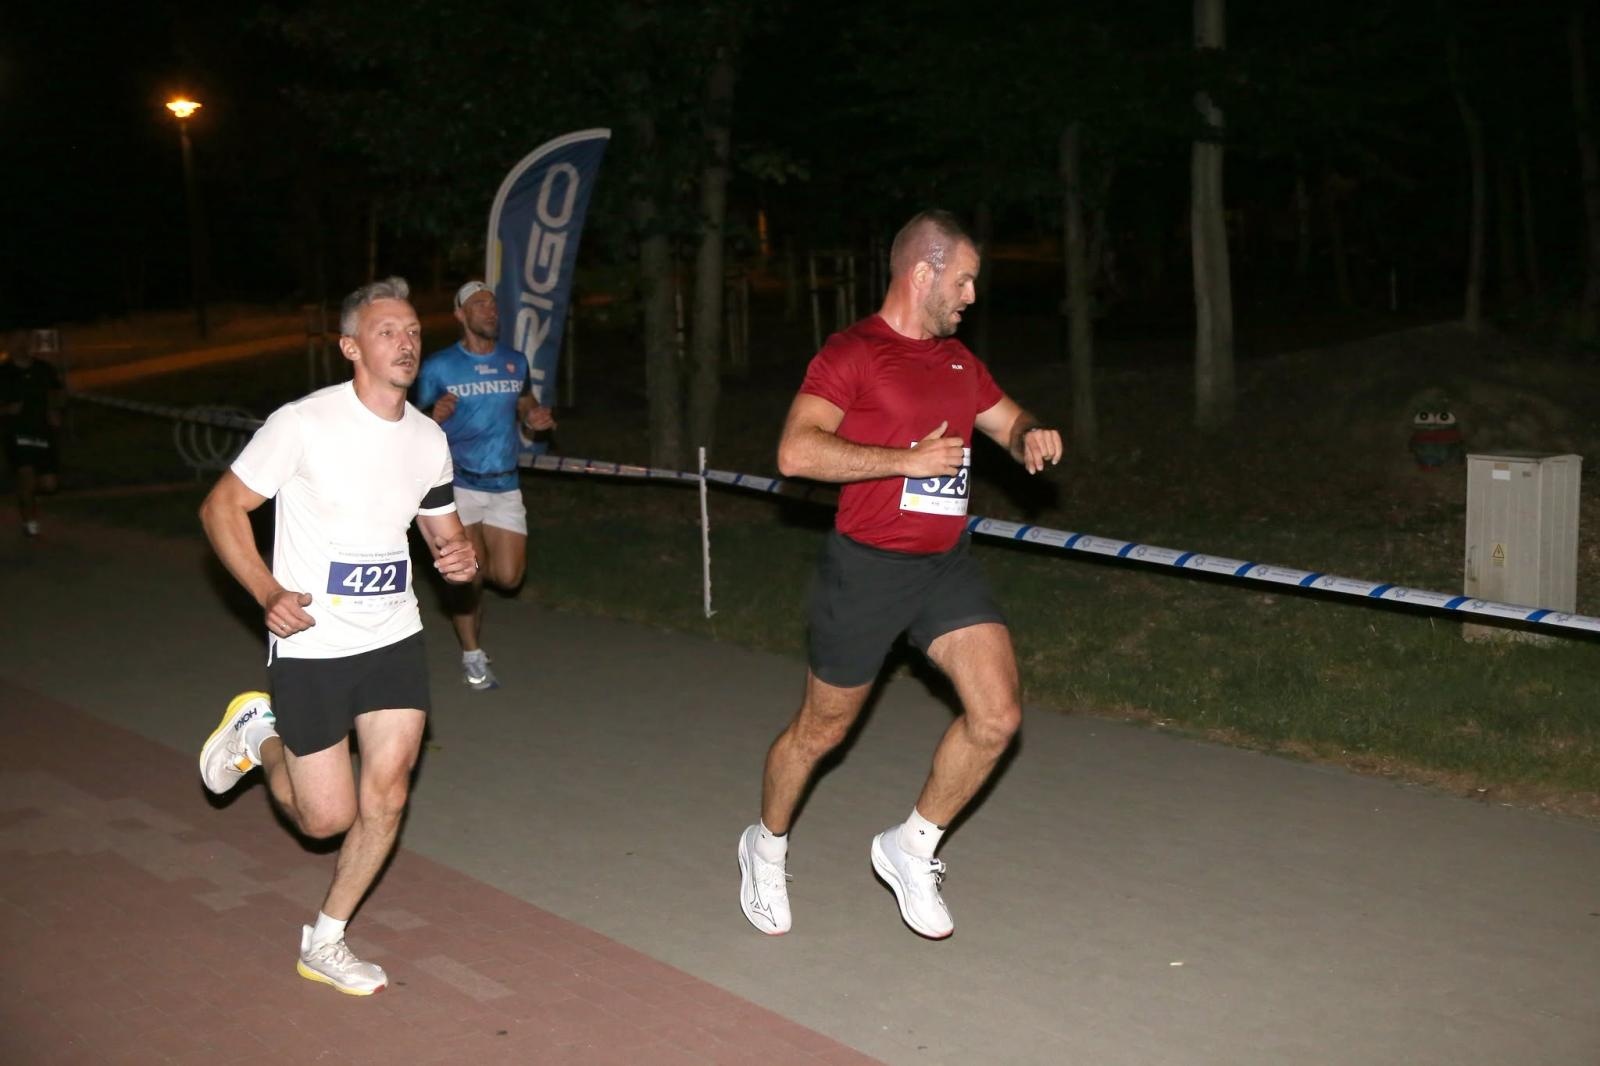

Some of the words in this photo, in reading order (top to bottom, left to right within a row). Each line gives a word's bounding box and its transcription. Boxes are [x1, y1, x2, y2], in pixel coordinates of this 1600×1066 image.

[513, 161, 580, 448] RIGO
[921, 468, 968, 496] 323
[342, 564, 397, 593] 422
[234, 707, 258, 732] HOKA
